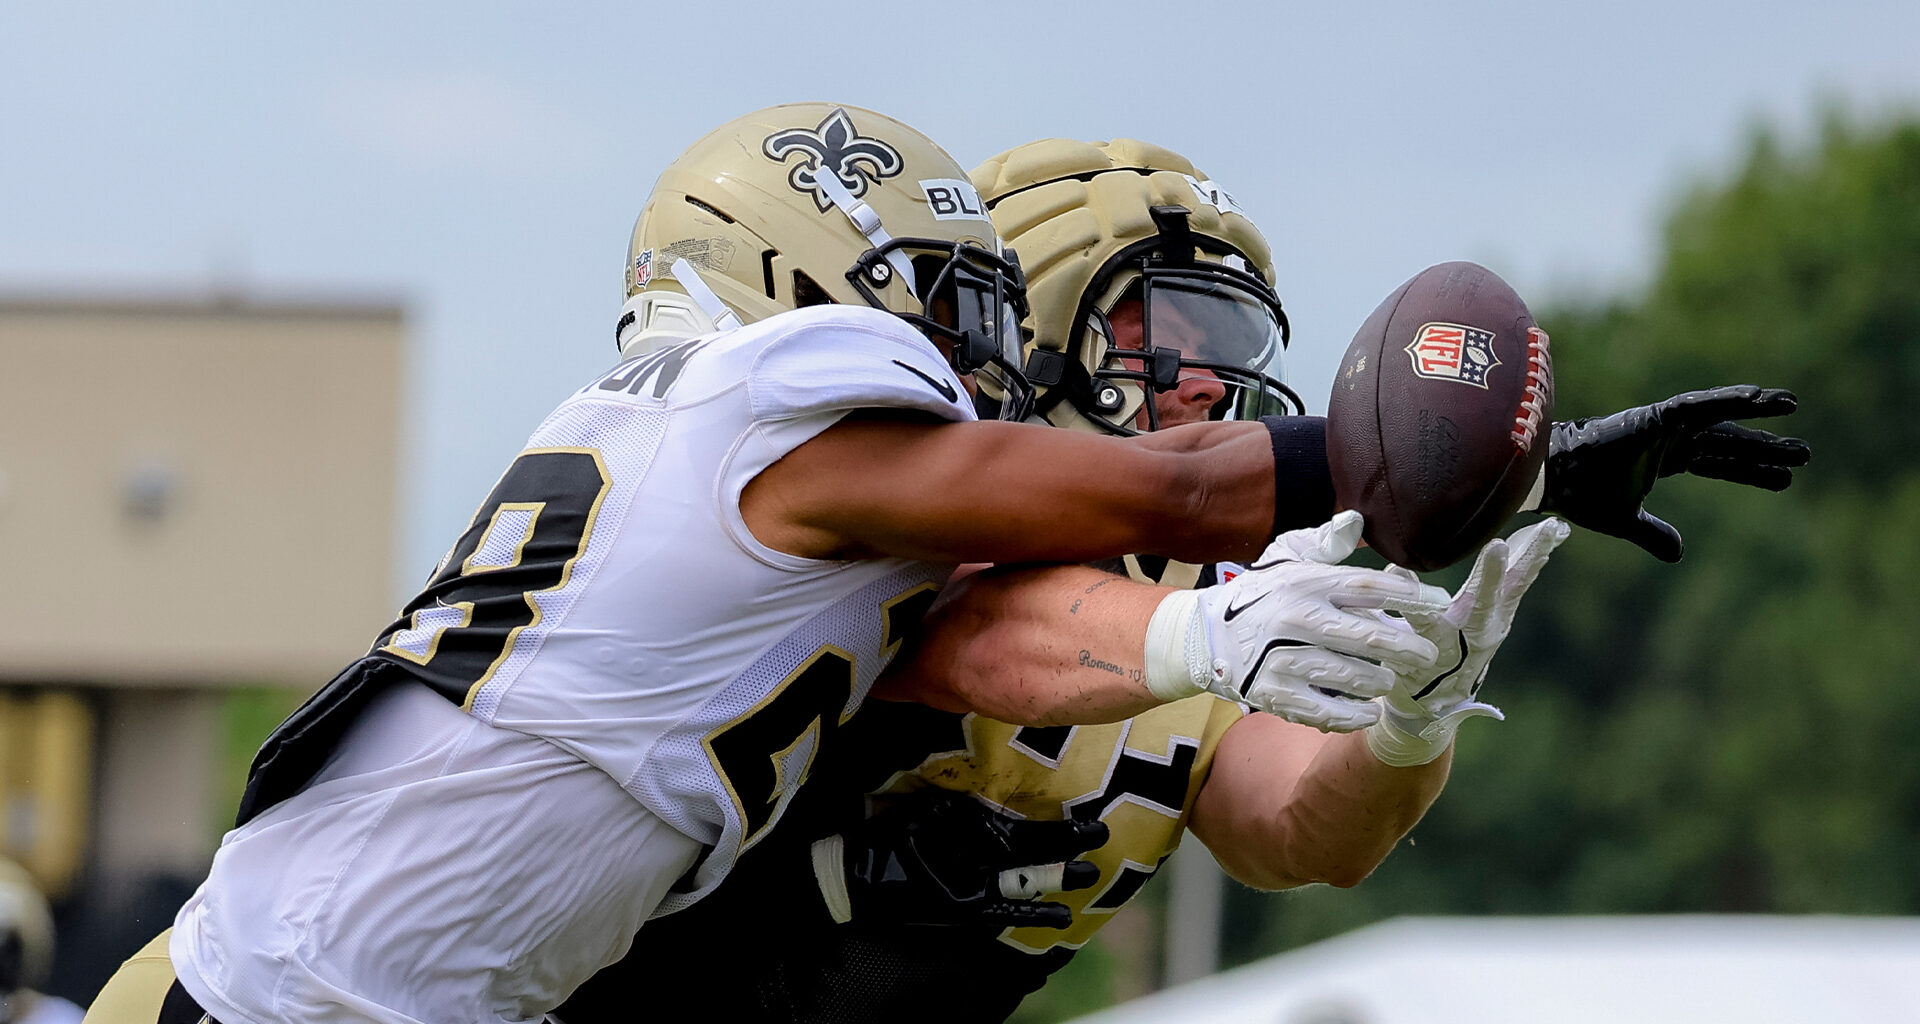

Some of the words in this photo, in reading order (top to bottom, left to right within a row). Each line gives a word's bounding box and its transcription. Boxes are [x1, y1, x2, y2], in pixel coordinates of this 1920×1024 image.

[637, 263, 651, 283] NFL
[1418, 328, 1463, 372] NFL
[1079, 650, 1125, 676] Romans
